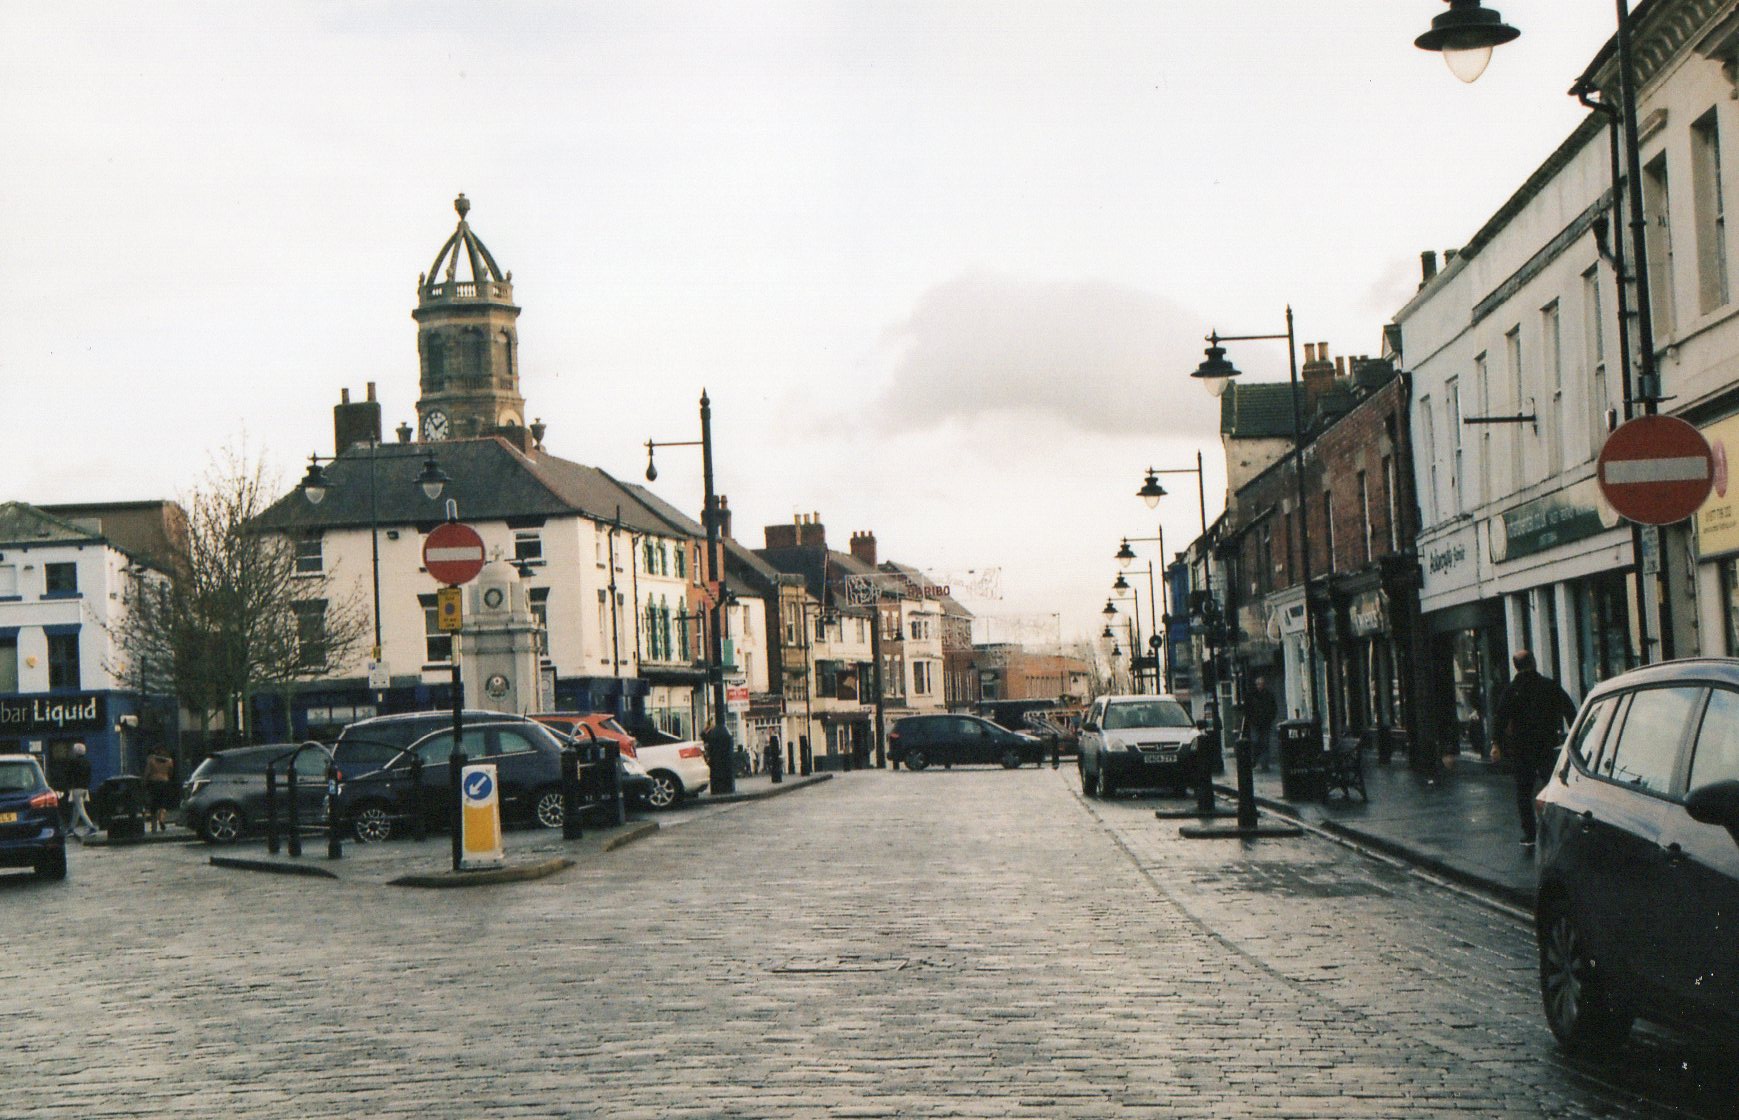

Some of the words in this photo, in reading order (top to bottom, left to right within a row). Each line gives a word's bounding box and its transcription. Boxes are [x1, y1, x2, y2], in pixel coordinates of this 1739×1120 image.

[907, 585, 951, 598] HARIBO
[1, 701, 27, 723] bar
[34, 697, 97, 727] Liquid
